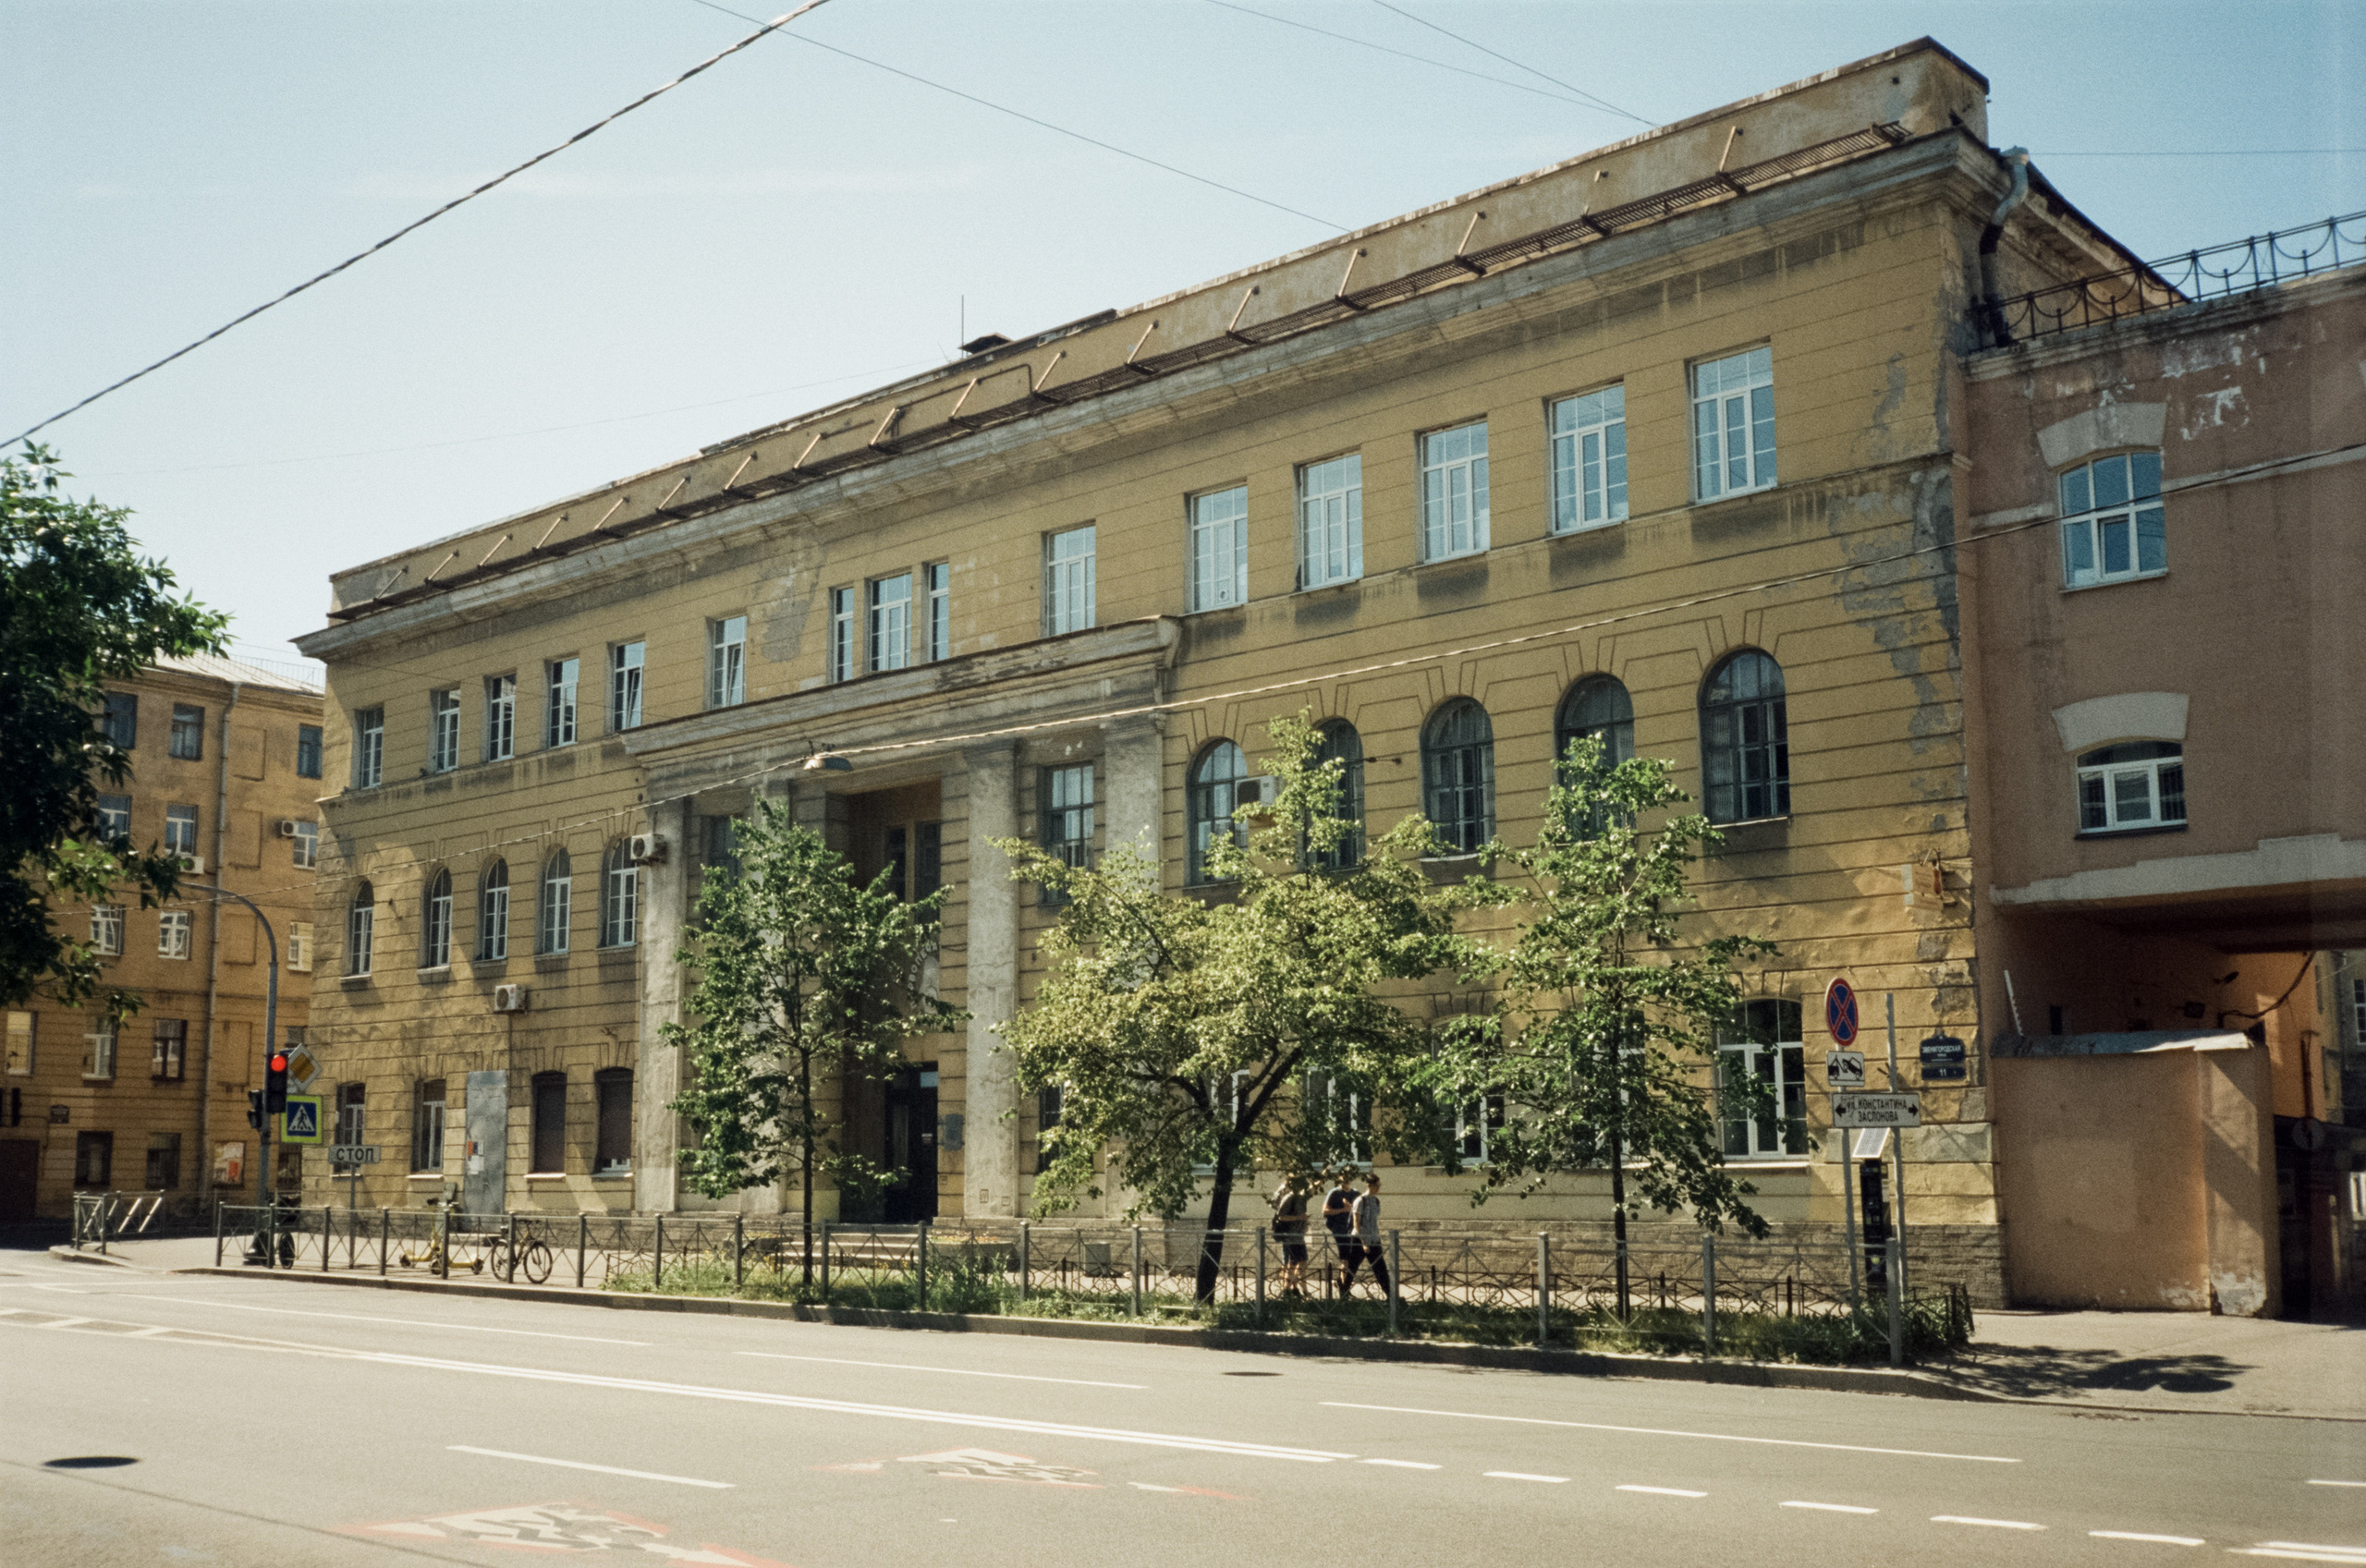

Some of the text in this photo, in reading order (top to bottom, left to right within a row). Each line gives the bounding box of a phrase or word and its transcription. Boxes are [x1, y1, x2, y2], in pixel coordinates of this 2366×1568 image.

[1939, 1068, 1946, 1077] 11
[1859, 1099, 1908, 1109] КОНСТАНТИНА
[1858, 1111, 1898, 1123] ЗАСЛОНОВА
[335, 1148, 374, 1161] СТОП
